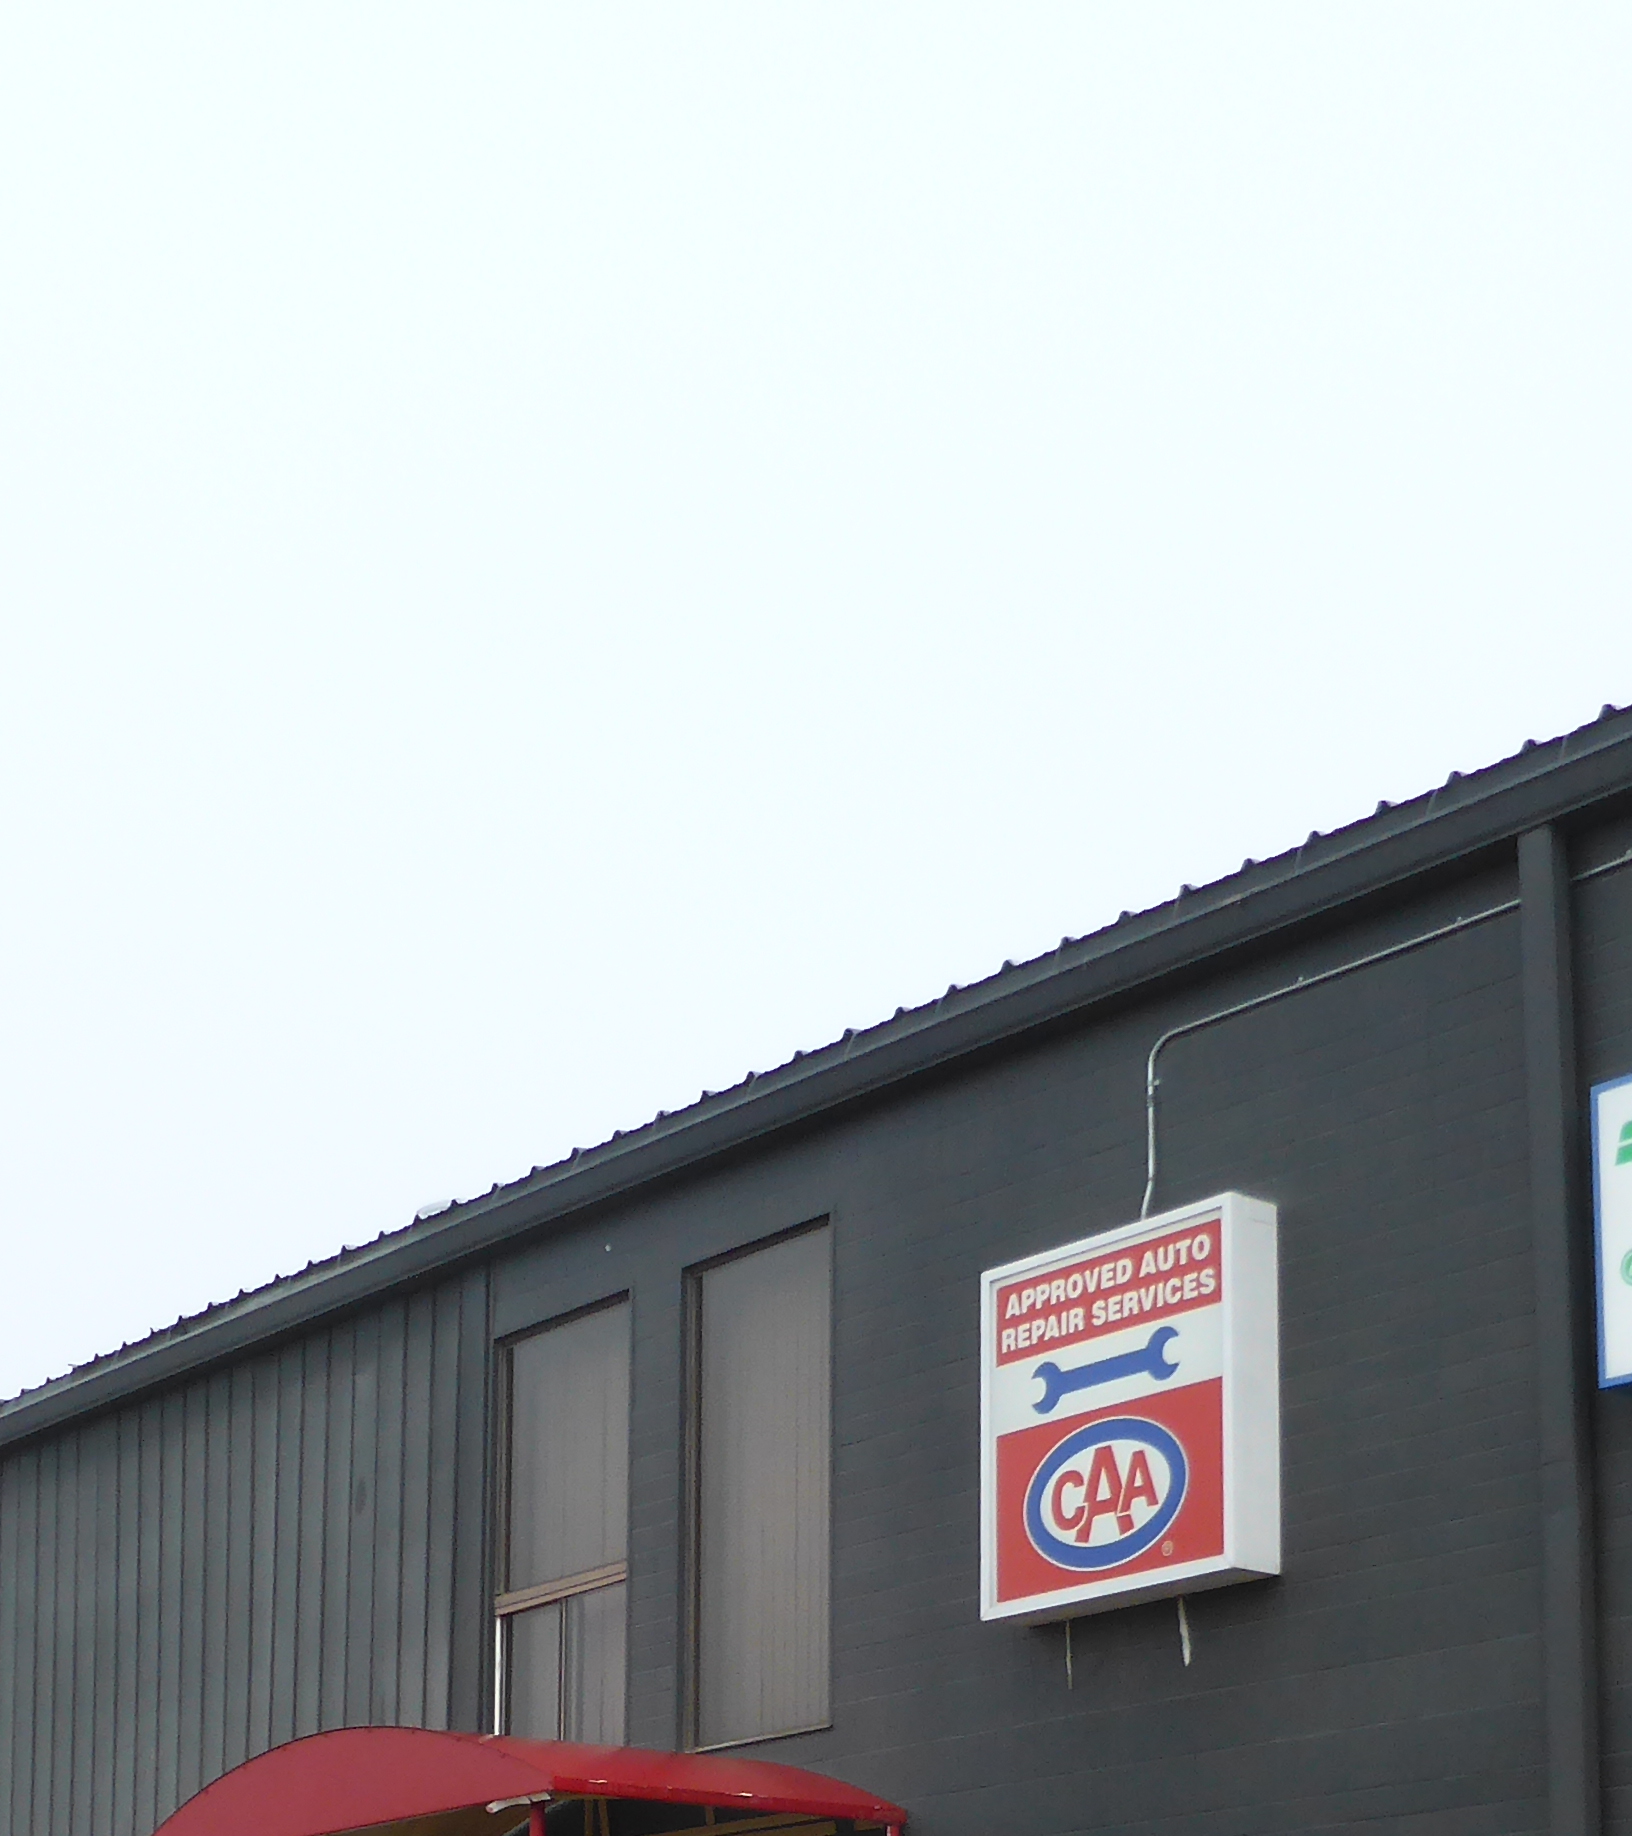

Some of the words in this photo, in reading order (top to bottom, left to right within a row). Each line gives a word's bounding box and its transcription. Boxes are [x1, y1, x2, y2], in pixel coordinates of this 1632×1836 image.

[1001, 1310, 1085, 1354] REPAIR
[1091, 1269, 1216, 1327] SERVICES
[1005, 1258, 1133, 1320] APPROVED
[1139, 1234, 1211, 1279] AUTO
[1051, 1445, 1159, 1544] CAA
